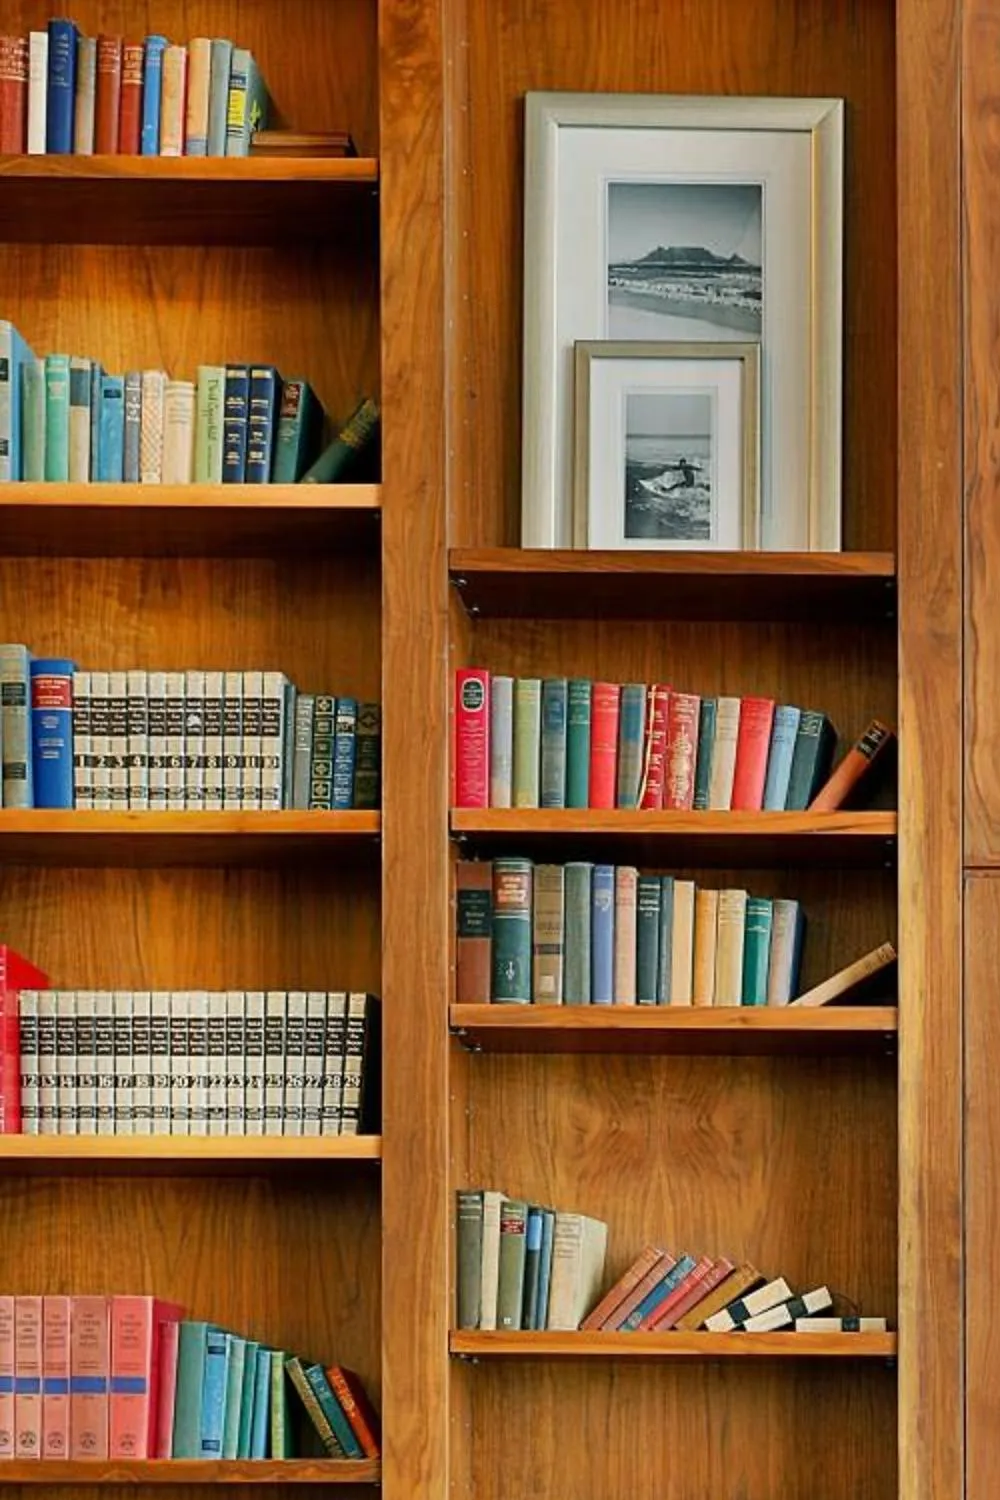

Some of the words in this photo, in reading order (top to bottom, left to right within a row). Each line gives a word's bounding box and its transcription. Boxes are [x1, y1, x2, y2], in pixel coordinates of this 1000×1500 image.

[79, 755, 85, 768] 1
[97, 755, 106, 768] 2
[133, 755, 142, 768] 4
[171, 755, 180, 768] 6
[188, 755, 198, 768] 7
[207, 755, 217, 768] 8
[227, 755, 237, 768] 9
[23, 1075, 35, 1088] 12
[99, 1075, 112, 1088] 16
[118, 1075, 130, 1088] 17
[172, 1075, 188, 1088] 20
[286, 1075, 302, 1088] 26
[325, 1075, 341, 1088] 28
[345, 1075, 361, 1088] 29
